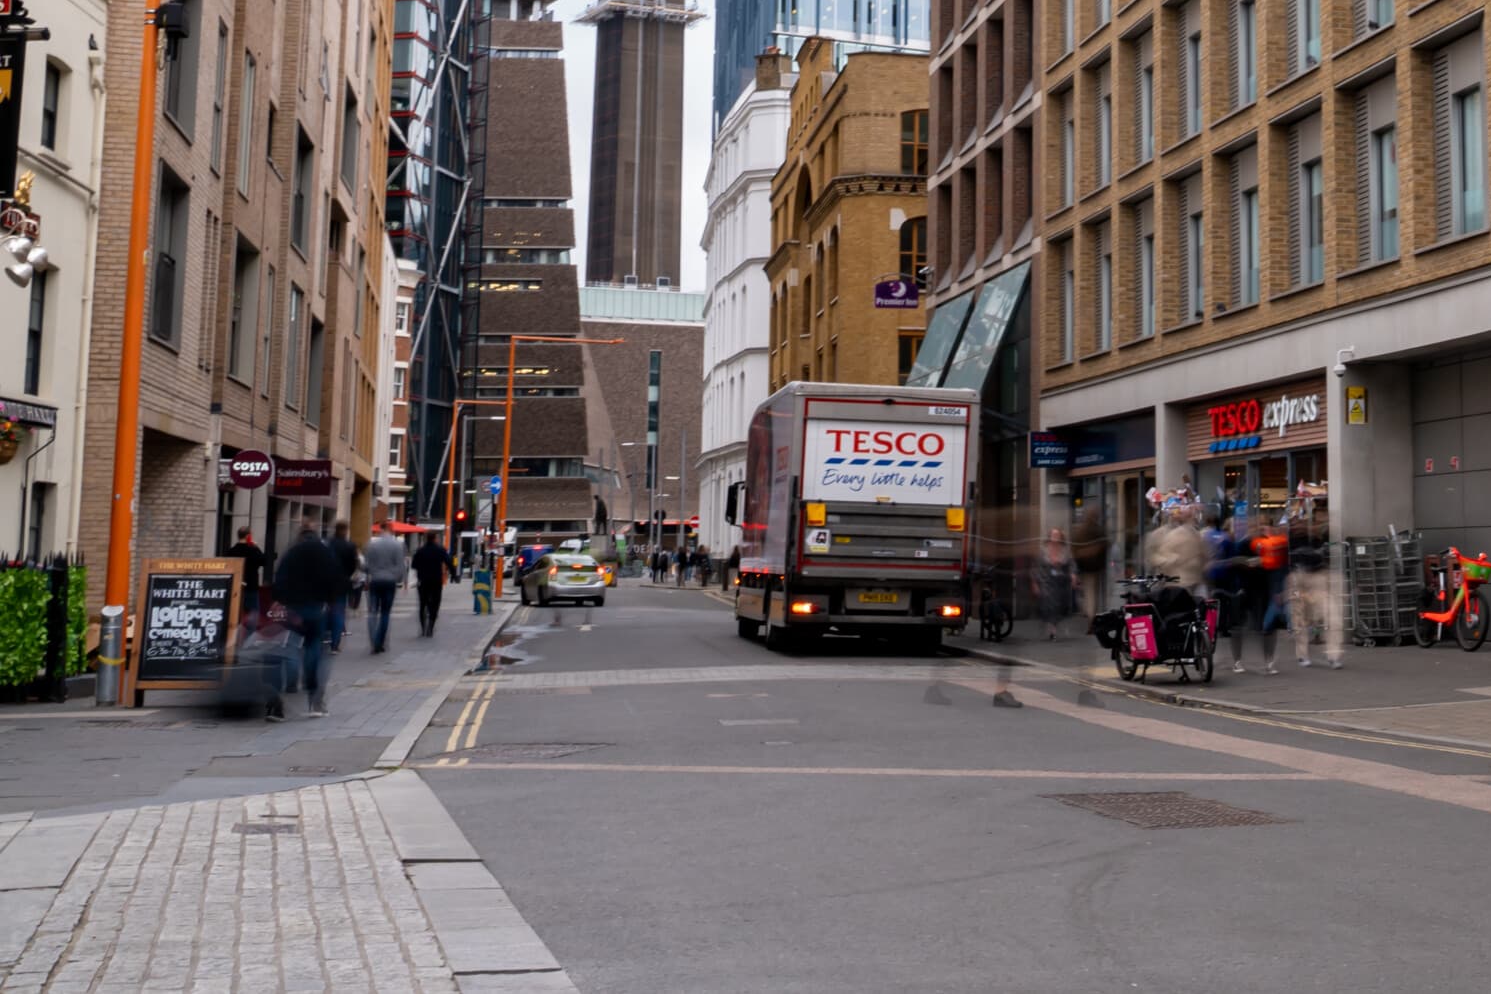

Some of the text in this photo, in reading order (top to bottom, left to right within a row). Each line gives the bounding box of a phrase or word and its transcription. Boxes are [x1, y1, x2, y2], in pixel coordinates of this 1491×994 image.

[1207, 393, 1319, 438] TESCO express
[826, 429, 945, 456] TESCO
[233, 462, 269, 471] COSTA
[277, 468, 329, 478] Sainsbury's
[822, 469, 945, 492] Every little helps
[176, 580, 205, 589] THE
[153, 589, 227, 599] WHITE HART
